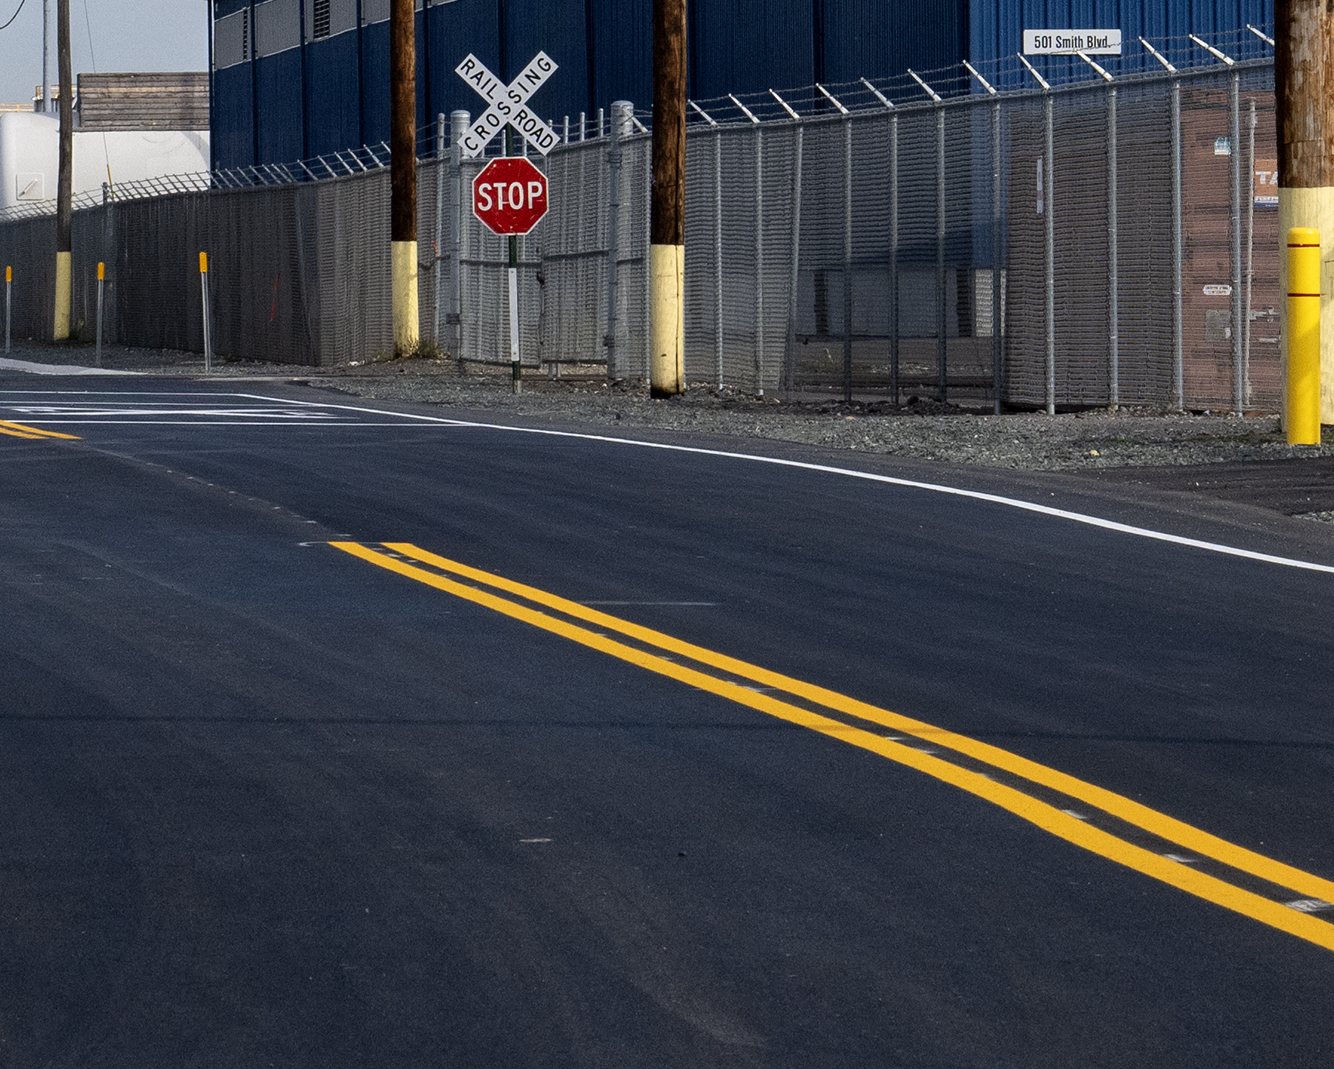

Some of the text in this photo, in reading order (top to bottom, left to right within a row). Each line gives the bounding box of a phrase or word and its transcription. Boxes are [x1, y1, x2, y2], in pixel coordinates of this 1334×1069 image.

[1034, 35, 1111, 49] 501 Smith Blvd.
[464, 58, 552, 151] CROSSING
[477, 181, 543, 212] STOP
